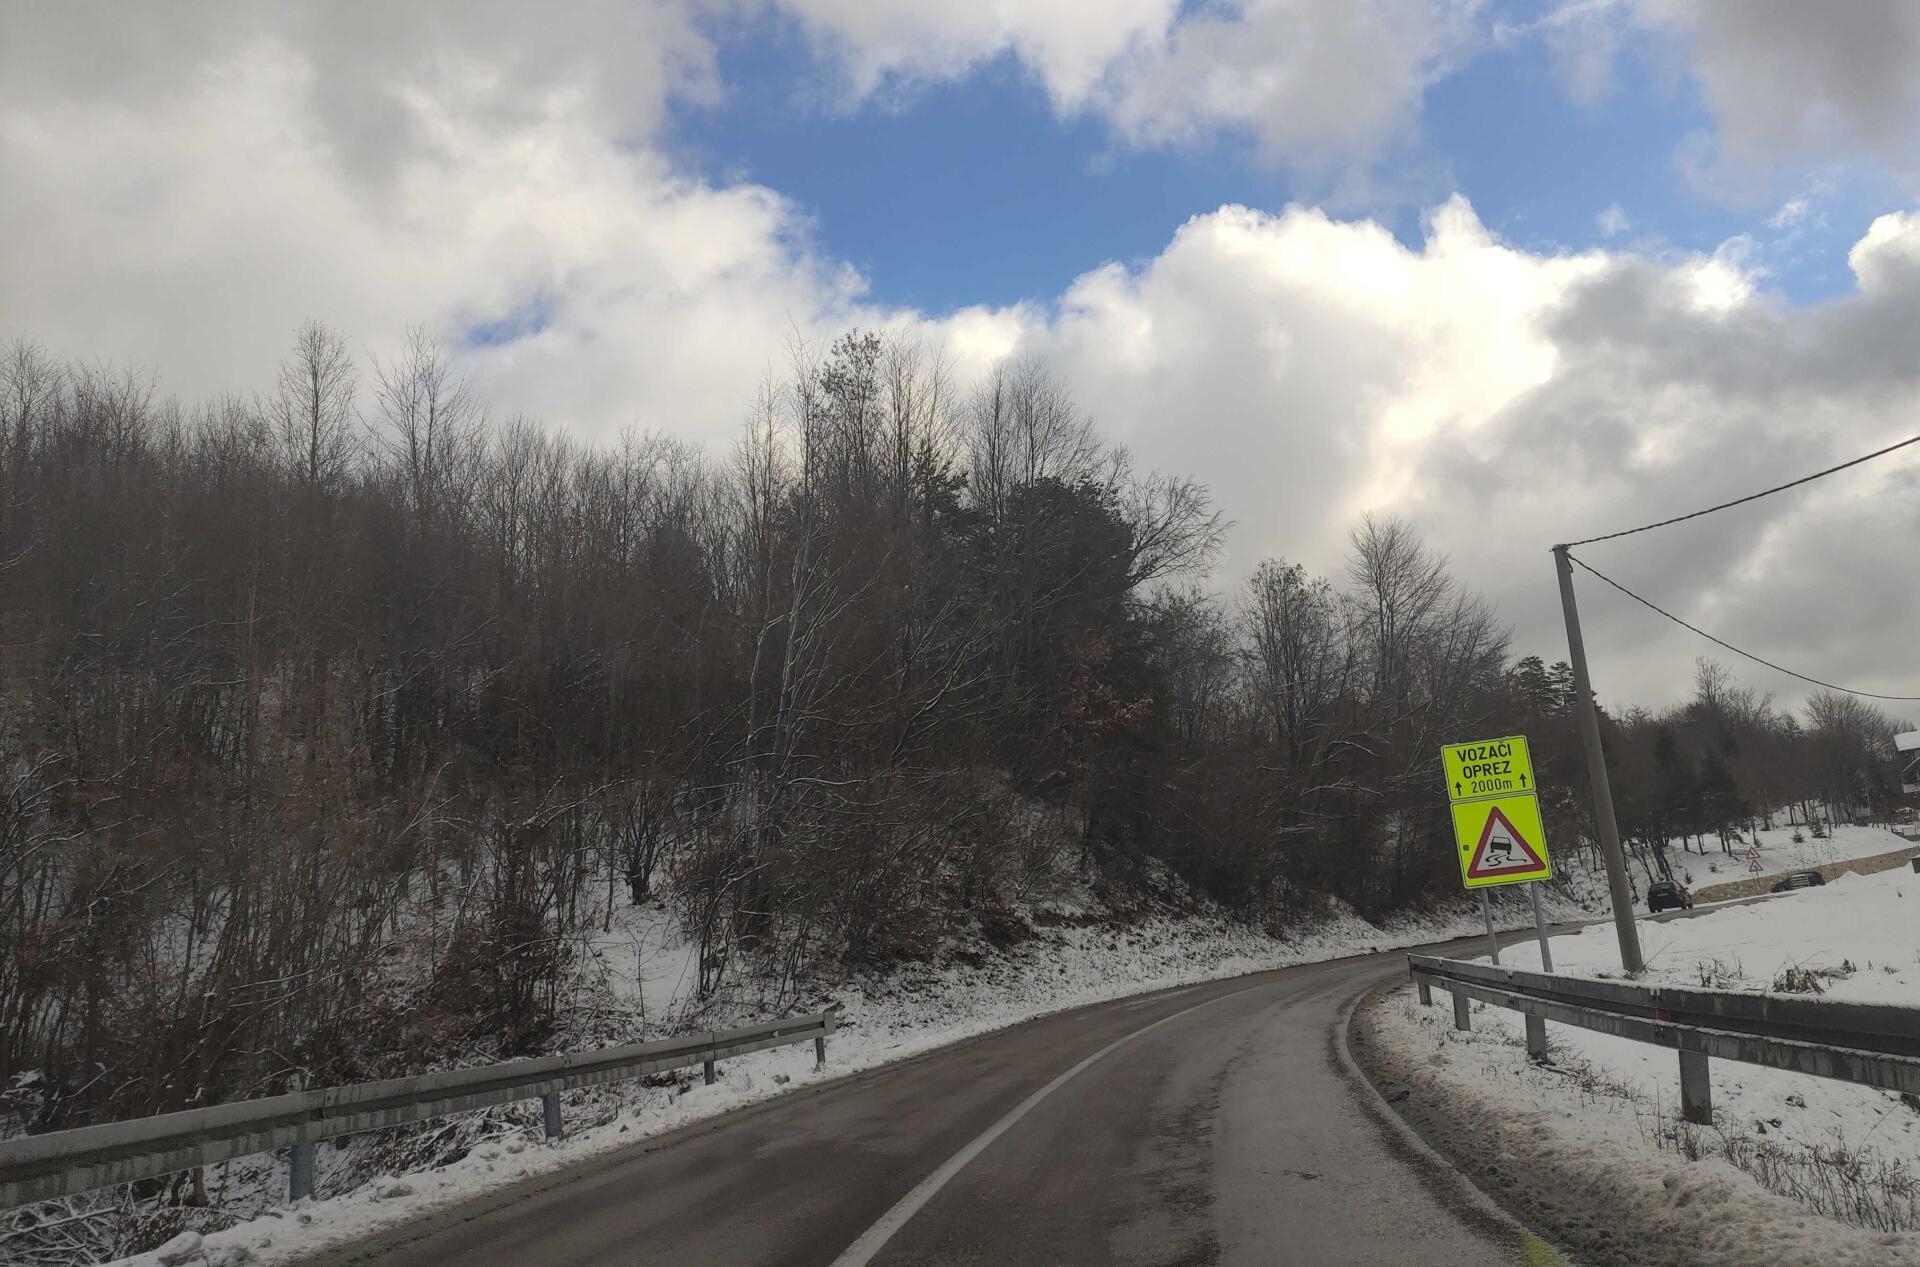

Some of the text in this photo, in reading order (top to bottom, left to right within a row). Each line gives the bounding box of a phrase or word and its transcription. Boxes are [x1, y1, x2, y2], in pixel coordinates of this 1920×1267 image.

[1457, 741, 1512, 762] VOZAČI
[1463, 761, 1512, 779] OPREZ
[1471, 778, 1512, 793] 2000m
